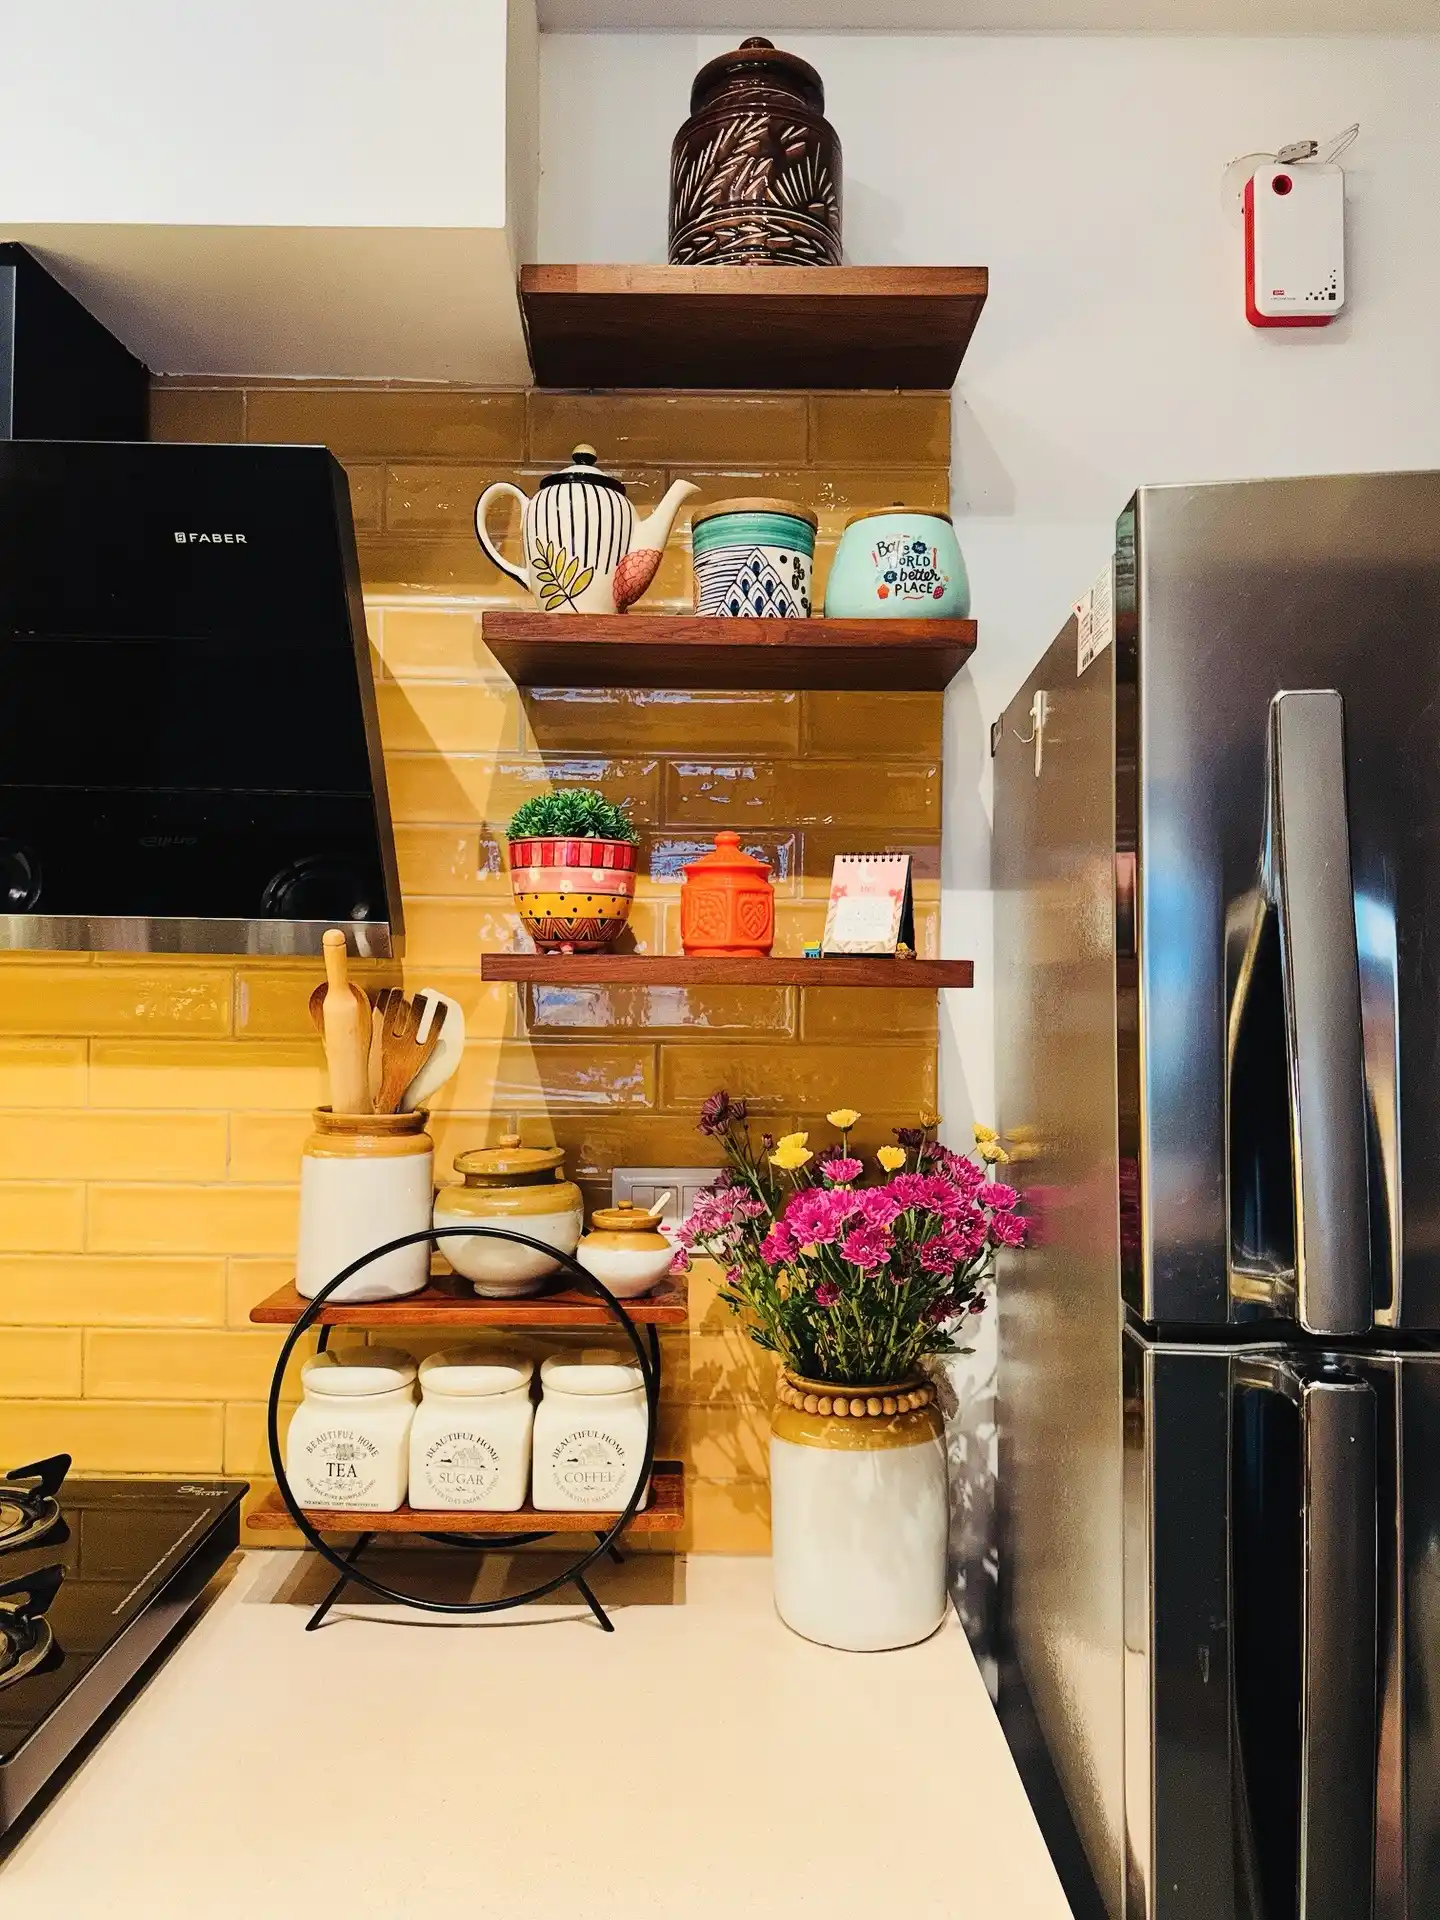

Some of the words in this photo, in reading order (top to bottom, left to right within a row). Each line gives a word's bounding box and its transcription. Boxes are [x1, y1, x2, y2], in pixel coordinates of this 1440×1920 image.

[188, 532, 248, 544] FABER
[876, 540, 910, 558] Bae
[899, 568, 941, 581] better
[894, 581, 934, 597] PLACE
[305, 1429, 355, 1454] BEAUTIFUL
[357, 1435, 380, 1458] HOME
[426, 1432, 475, 1459] BEAUTIFUL
[476, 1436, 500, 1464] HOME
[552, 1429, 600, 1459] BEAUTIFUL
[601, 1433, 625, 1459] HOME
[325, 1461, 359, 1478] TEA
[564, 1471, 615, 1484] COFFEE
[439, 1472, 485, 1486] SUGAR
